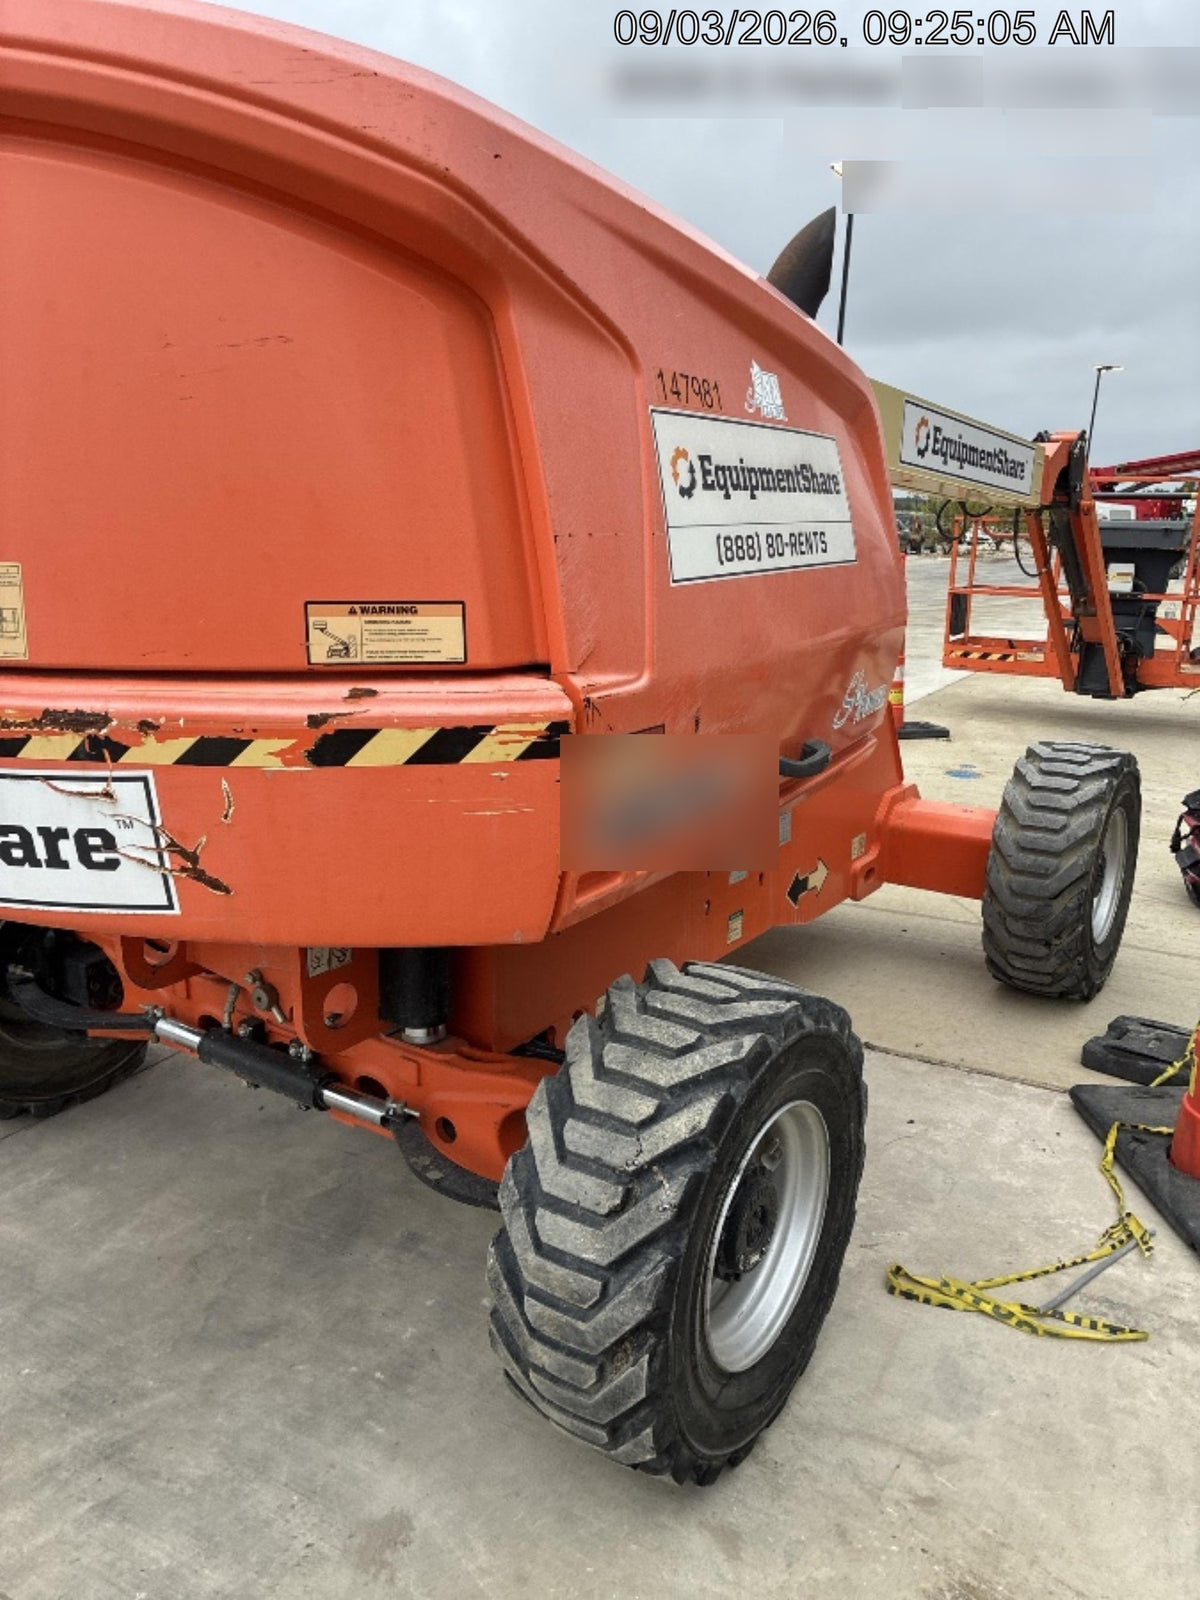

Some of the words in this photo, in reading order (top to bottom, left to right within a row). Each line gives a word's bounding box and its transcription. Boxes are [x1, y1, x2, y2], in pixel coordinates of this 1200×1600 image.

[657, 368, 722, 411] 147981
[931, 425, 1026, 480] EquipmentShare
[698, 455, 842, 500] EquipmentShare
[716, 533, 762, 565] (888)
[766, 531, 828, 558] 80-RENTS
[359, 605, 418, 615] WARNING
